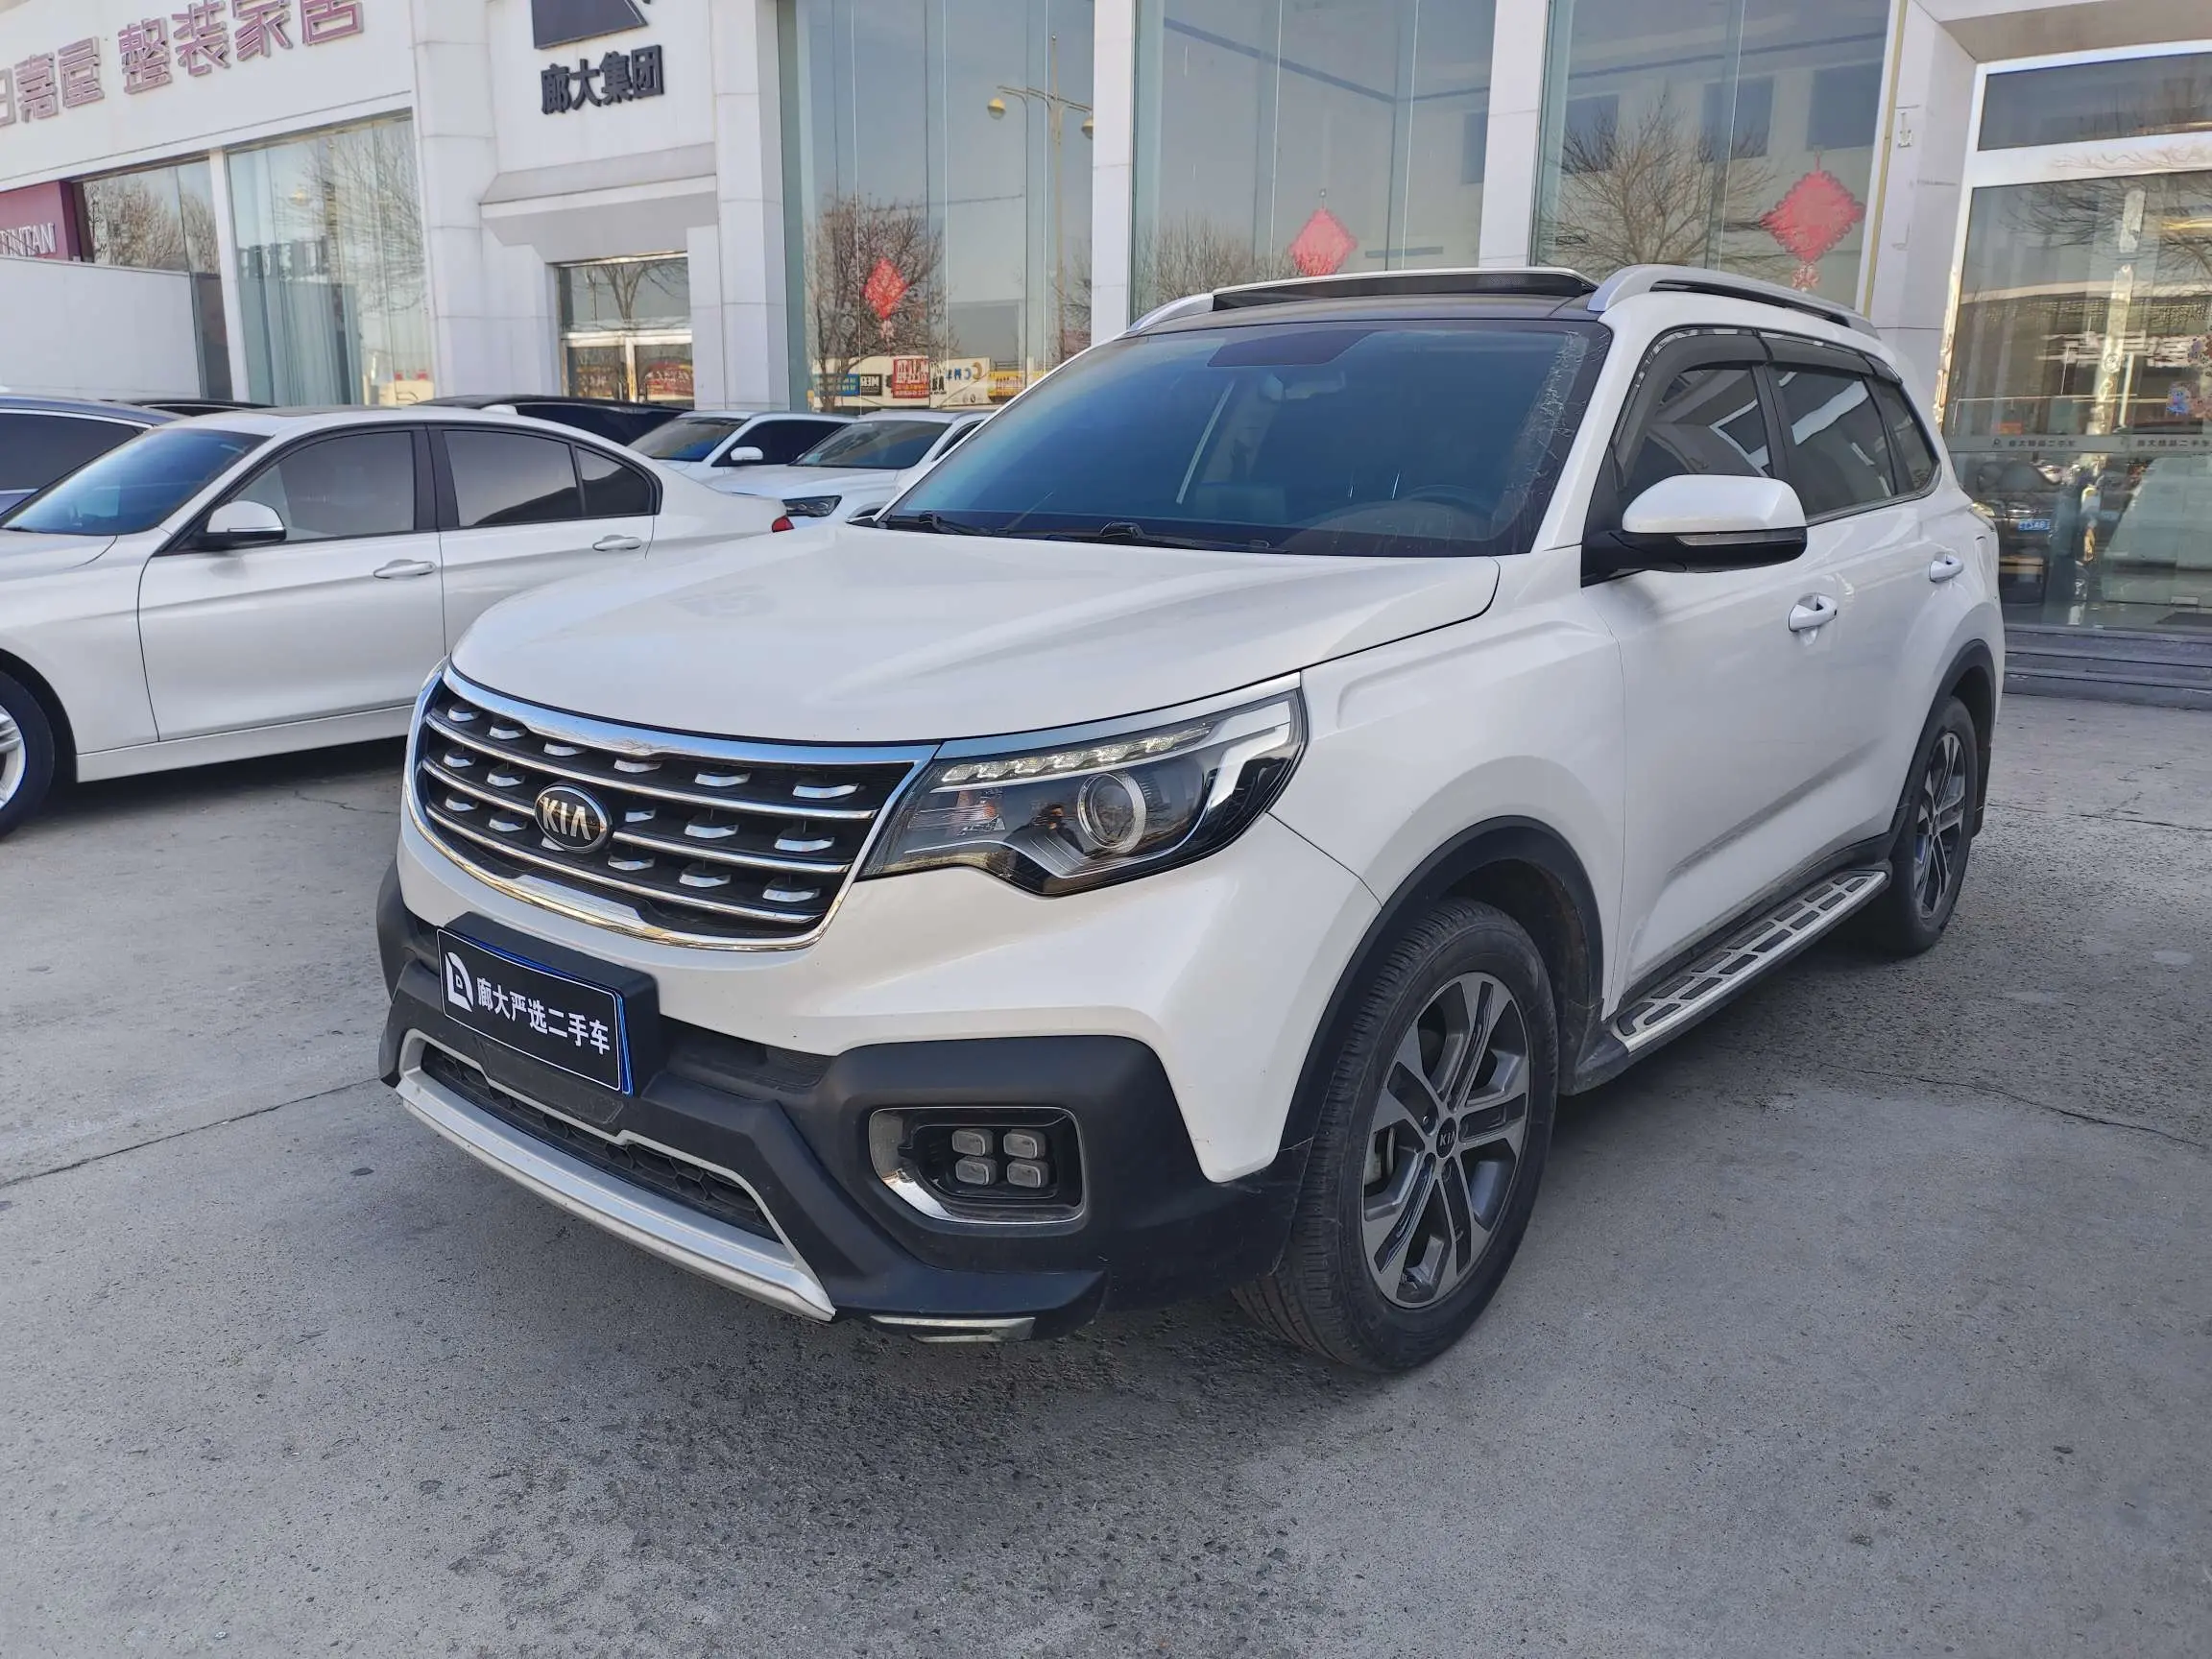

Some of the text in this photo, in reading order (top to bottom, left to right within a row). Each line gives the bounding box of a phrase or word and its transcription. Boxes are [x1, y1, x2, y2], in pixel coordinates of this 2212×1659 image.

[0, 36, 104, 127] 嘉屋
[541, 45, 664, 115] 廊大集团
[542, 796, 591, 840] KIA
[476, 977, 611, 1055] 廊大严选二手车
[1440, 1131, 1456, 1146] KIA
